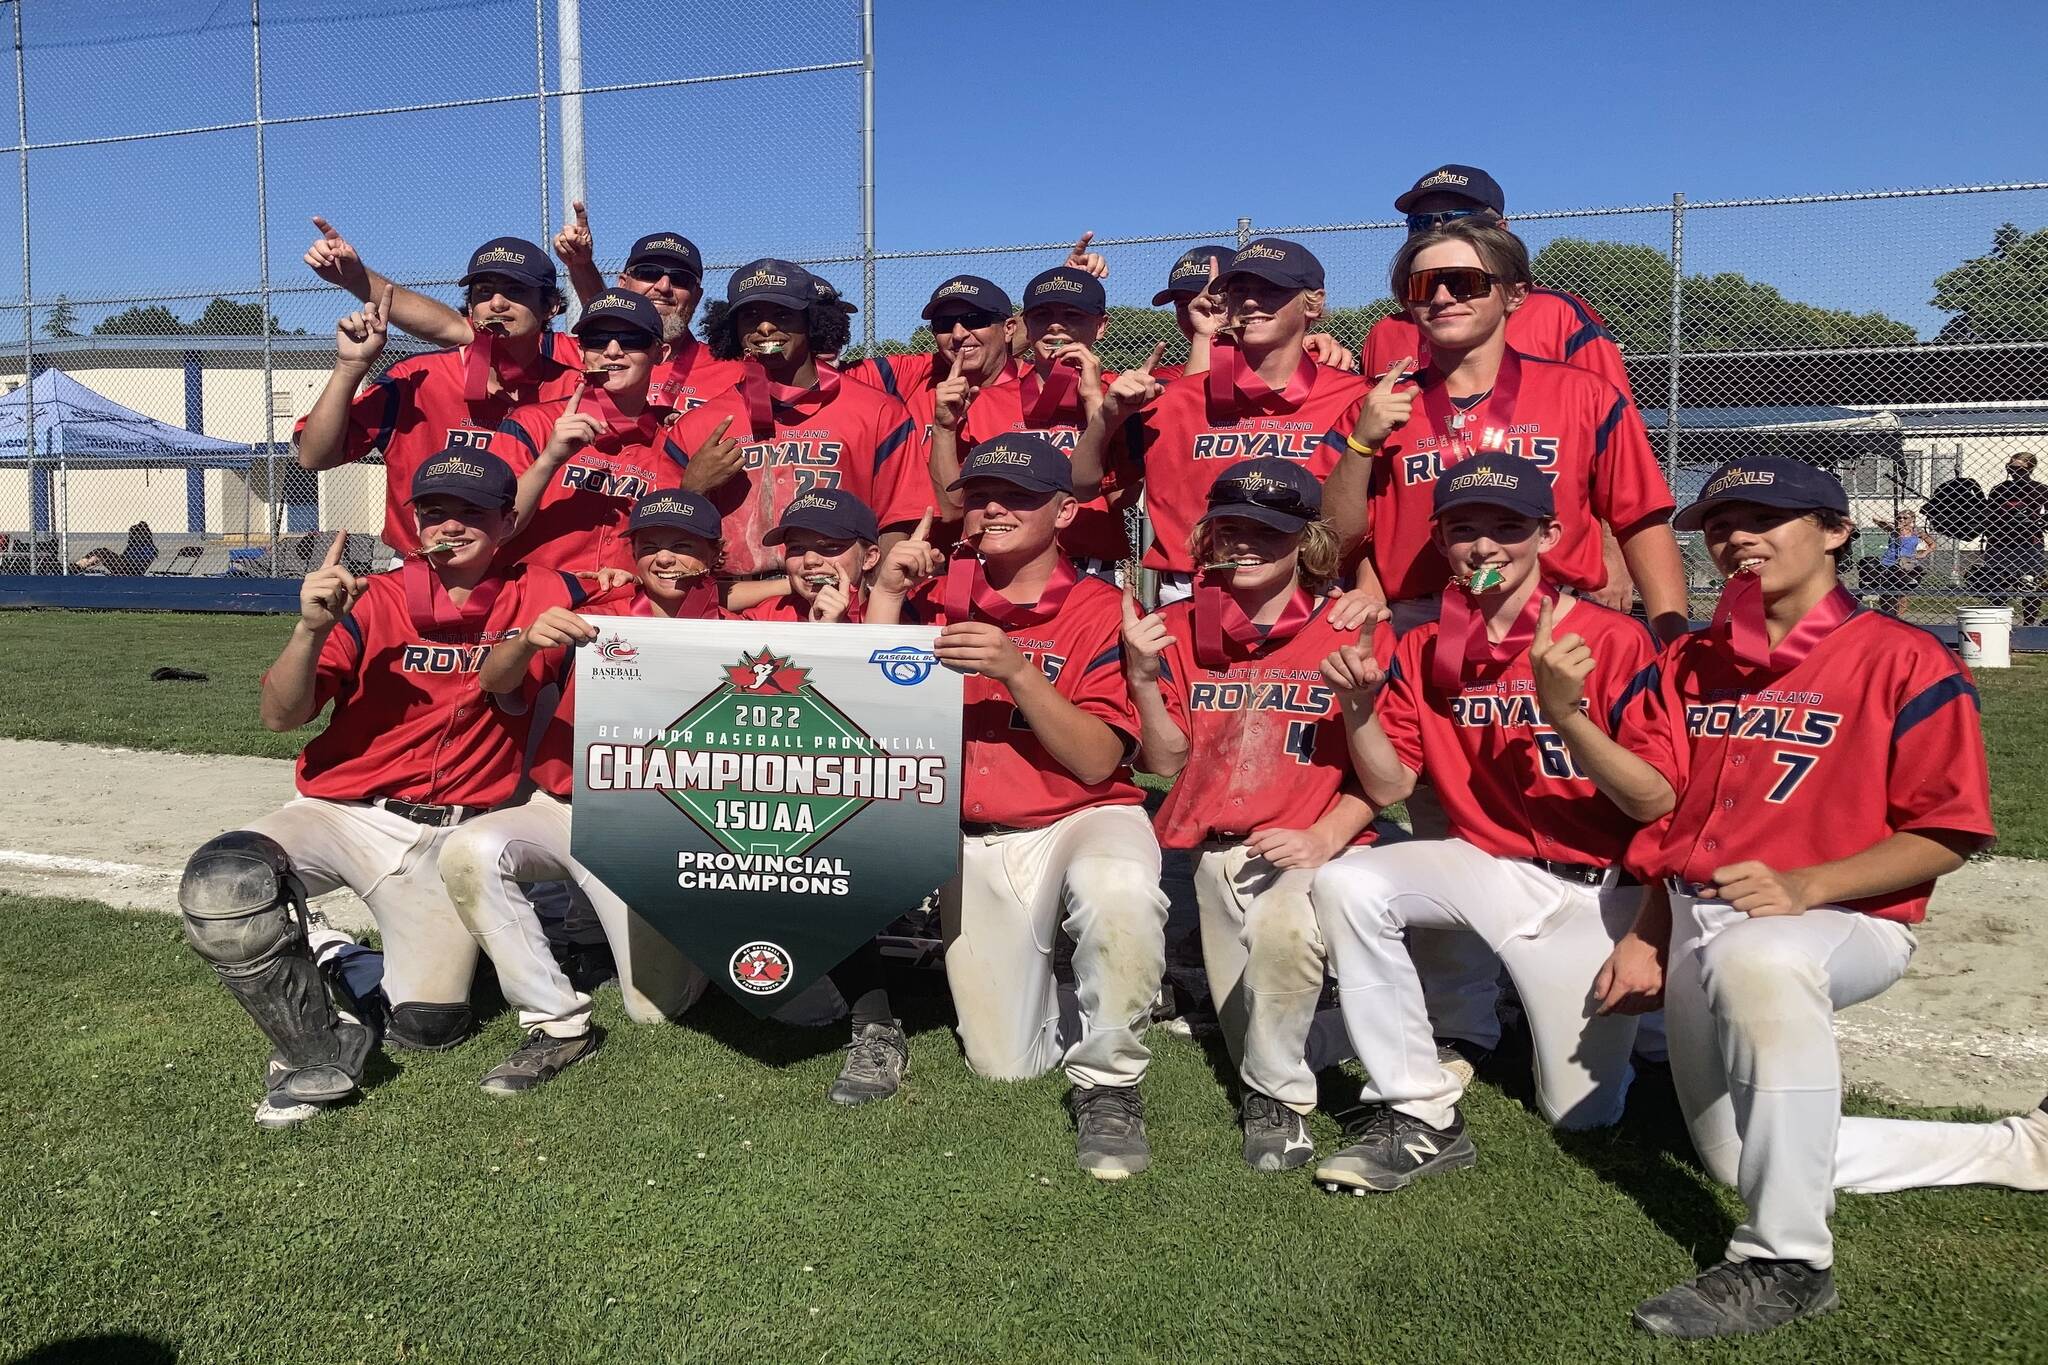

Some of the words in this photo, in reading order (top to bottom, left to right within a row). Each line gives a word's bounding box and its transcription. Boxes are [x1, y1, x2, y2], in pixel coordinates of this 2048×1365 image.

[1421, 173, 1468, 188] ROYALS
[645, 241, 689, 256] ROYALS
[477, 251, 525, 265] ROYALS
[740, 275, 787, 292] ROYALS
[939, 285, 979, 297] ROYALS
[1035, 281, 1083, 295] ROYALS
[588, 298, 636, 313] ROYALS
[782, 430, 830, 438] ISLAND
[1261, 420, 1313, 431] ISLAND
[742, 442, 842, 471] OYALS
[973, 452, 1031, 467] ROYALS
[426, 462, 484, 477] ROYALS
[579, 455, 621, 471] SOUTH
[625, 464, 656, 480] ISLAN
[562, 463, 654, 500] ROYAL
[1450, 473, 1518, 491] ROYALS
[1708, 472, 1774, 496] ROYALS
[640, 502, 694, 517] ROYALS
[787, 498, 837, 516] ROYALS
[592, 668, 641, 676] BASEBALL
[1207, 669, 1258, 679] SOUTH
[1264, 669, 1321, 681] ISLAND
[1511, 680, 1536, 692] ISL
[1190, 682, 1335, 716] ROYALS
[1758, 690, 1824, 706] ISLAND
[735, 705, 801, 728] 2022
[1686, 704, 1844, 748] ROYALS
[599, 725, 620, 738] BC
[633, 728, 693, 743] MINOR
[705, 732, 804, 748] BASEBALL
[814, 737, 936, 750] PROVINCIAL
[1283, 719, 1319, 765] 4
[1534, 731, 1589, 780] 6
[587, 743, 945, 804] CHAMPIONSHIPS
[1764, 750, 1819, 804] 7
[714, 800, 768, 830] 15U
[772, 803, 815, 833] AA
[677, 851, 851, 876] PROVINCIAL
[677, 871, 850, 895] CHAMPIONS
